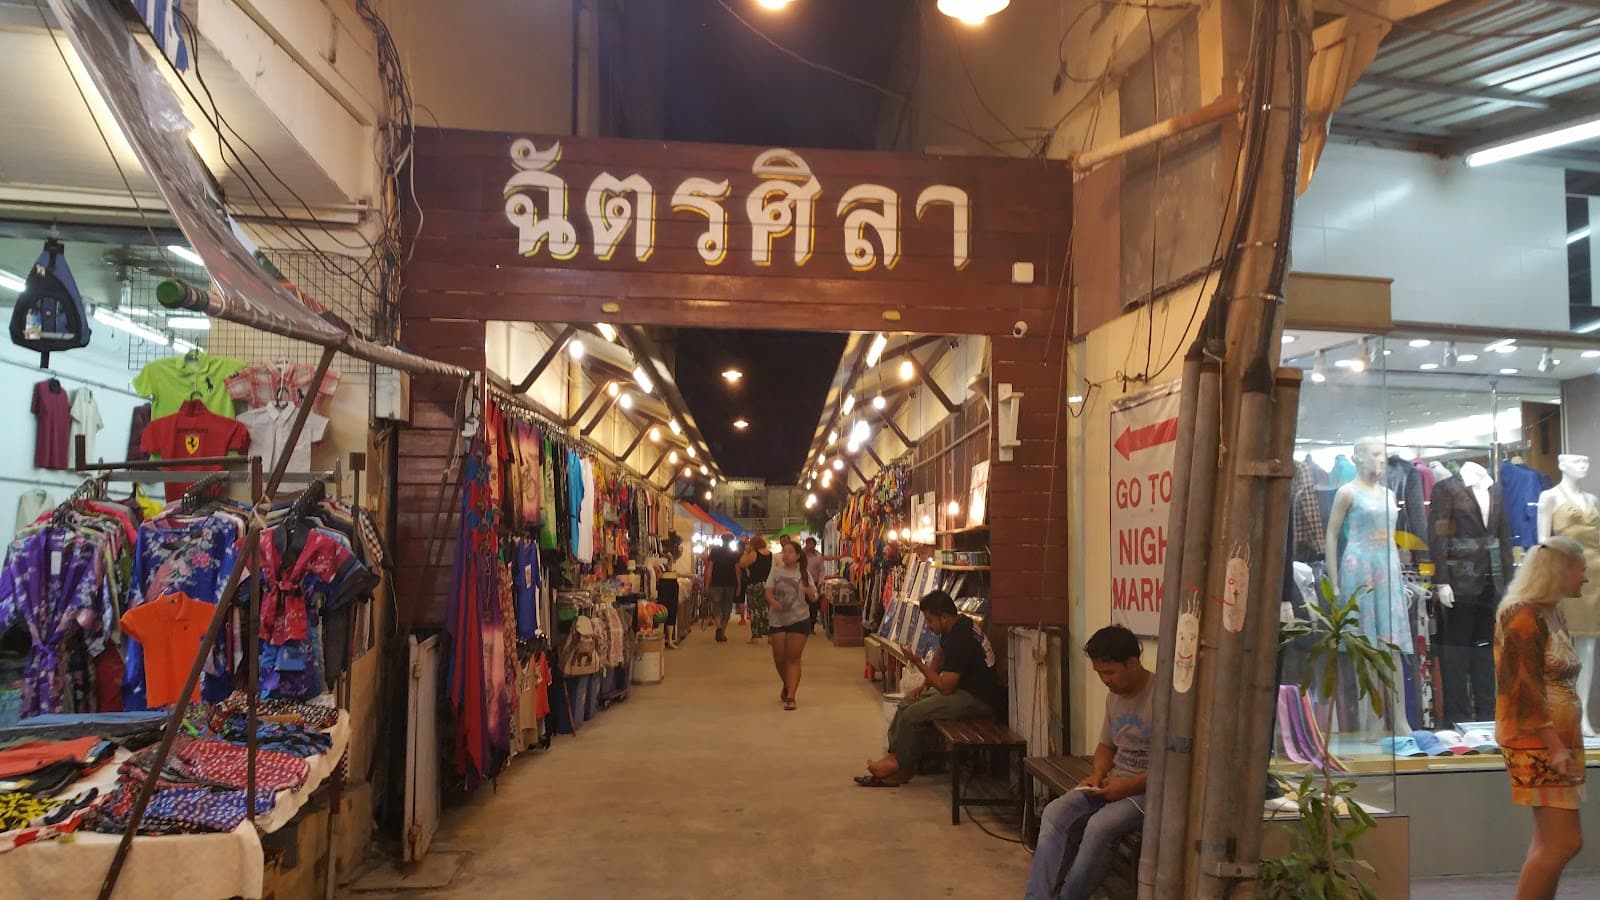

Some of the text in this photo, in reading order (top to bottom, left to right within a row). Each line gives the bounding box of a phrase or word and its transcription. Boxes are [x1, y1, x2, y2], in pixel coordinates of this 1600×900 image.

[503, 138, 971, 271] ฉัตรศิลา
[1116, 470, 1173, 509] GO TO
